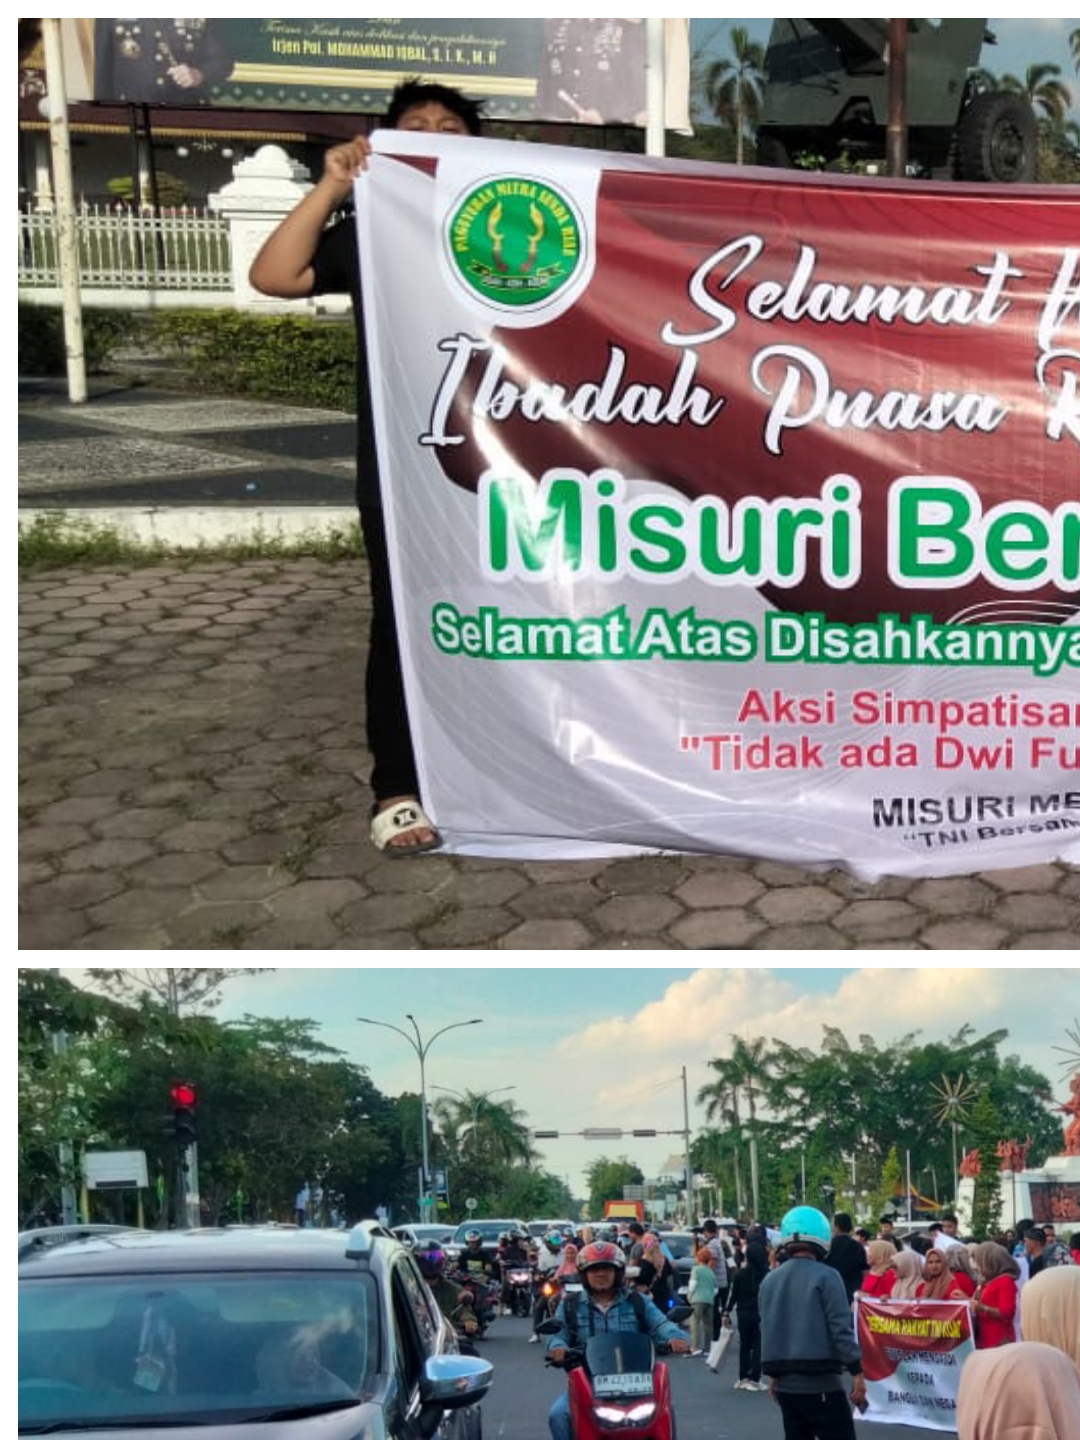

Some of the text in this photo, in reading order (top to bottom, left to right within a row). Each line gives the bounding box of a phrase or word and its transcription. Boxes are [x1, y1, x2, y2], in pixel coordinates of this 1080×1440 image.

[272, 38, 301, 55] Irjen
[303, 39, 325, 55] Pol.
[327, 41, 395, 59] MOHAMMAD
[397, 46, 432, 63] IQBAL,
[661, 234, 1023, 346] Selamat
[420, 334, 724, 447] Ibadah
[751, 343, 1008, 455] Puasa
[482, 475, 857, 583] Misuri
[434, 605, 626, 658] Selamat
[637, 613, 752, 659] Atas
[738, 689, 835, 724] Aksi
[681, 735, 824, 771] "Tidak
[839, 736, 918, 768] ada
[934, 736, 1014, 769] Dwi
[872, 795, 1015, 828] MISURI
